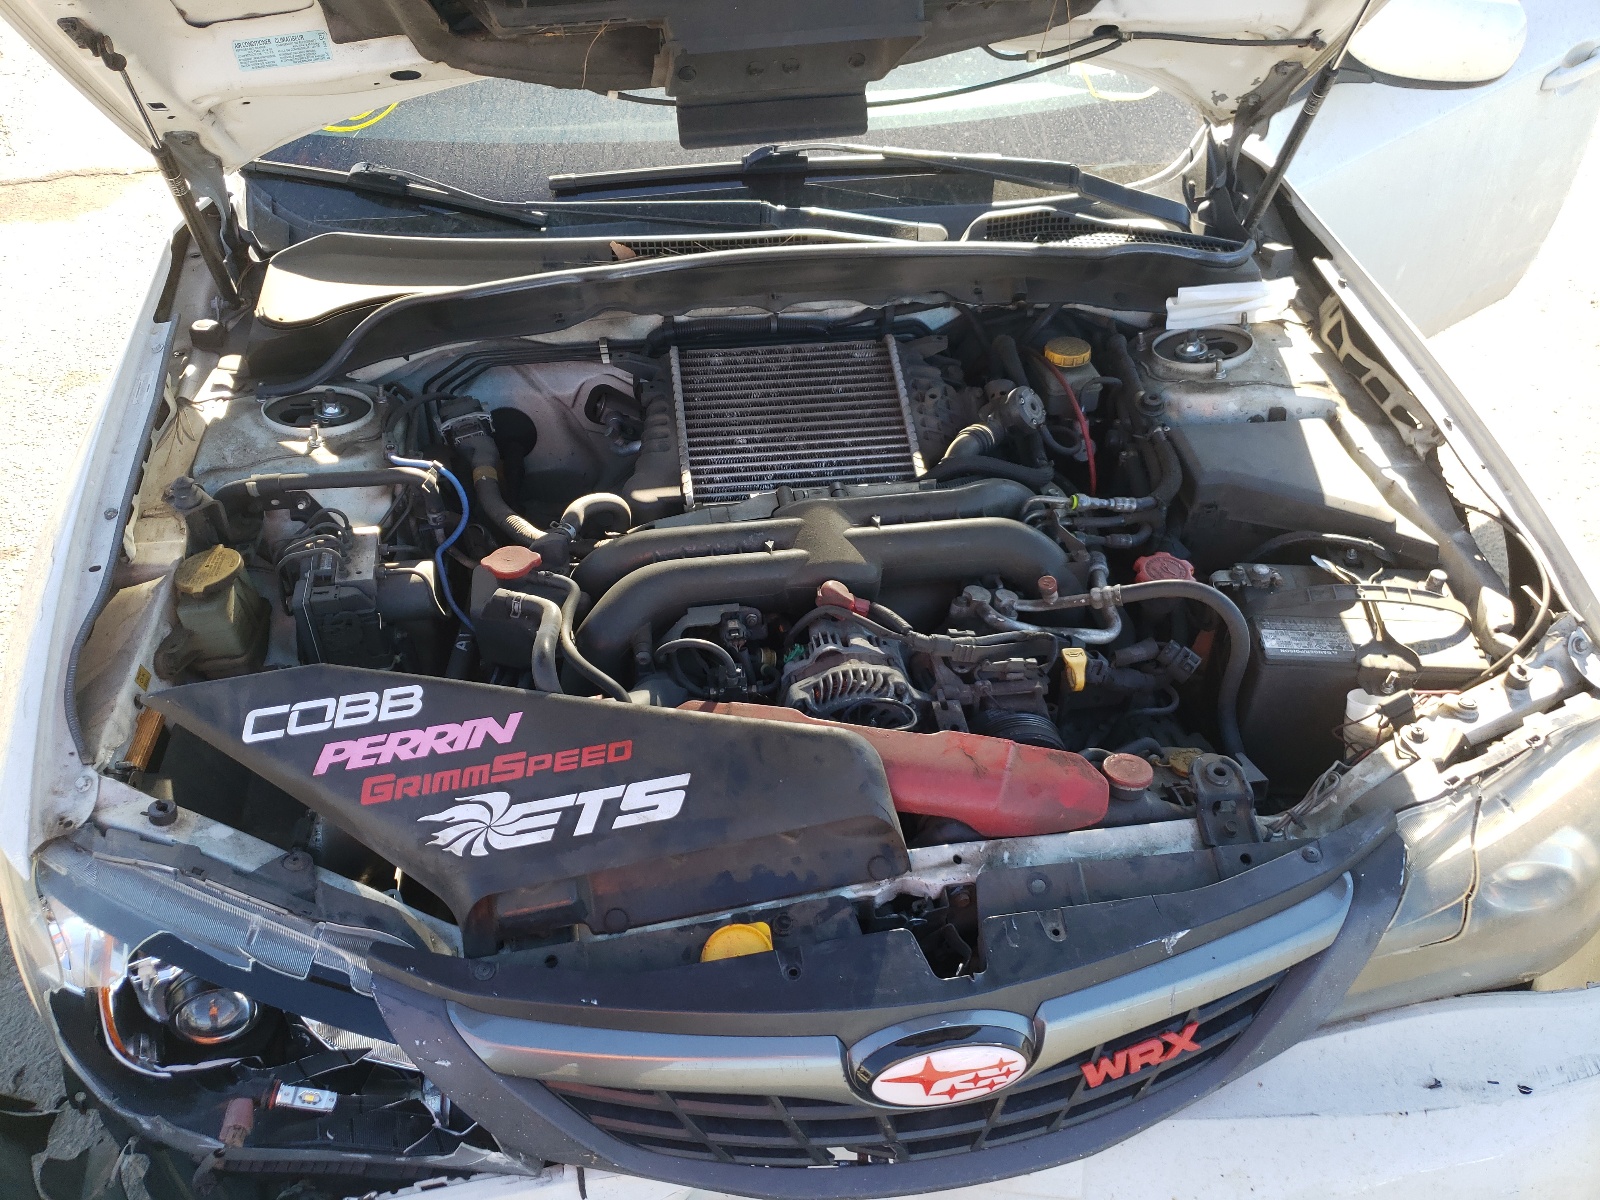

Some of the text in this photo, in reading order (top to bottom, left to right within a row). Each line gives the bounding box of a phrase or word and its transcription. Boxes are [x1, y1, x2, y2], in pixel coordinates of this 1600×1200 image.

[242, 684, 423, 744] COBB
[312, 711, 523, 776] PERRIN
[489, 772, 691, 850] ETS
[1081, 1020, 1202, 1089] WRX
